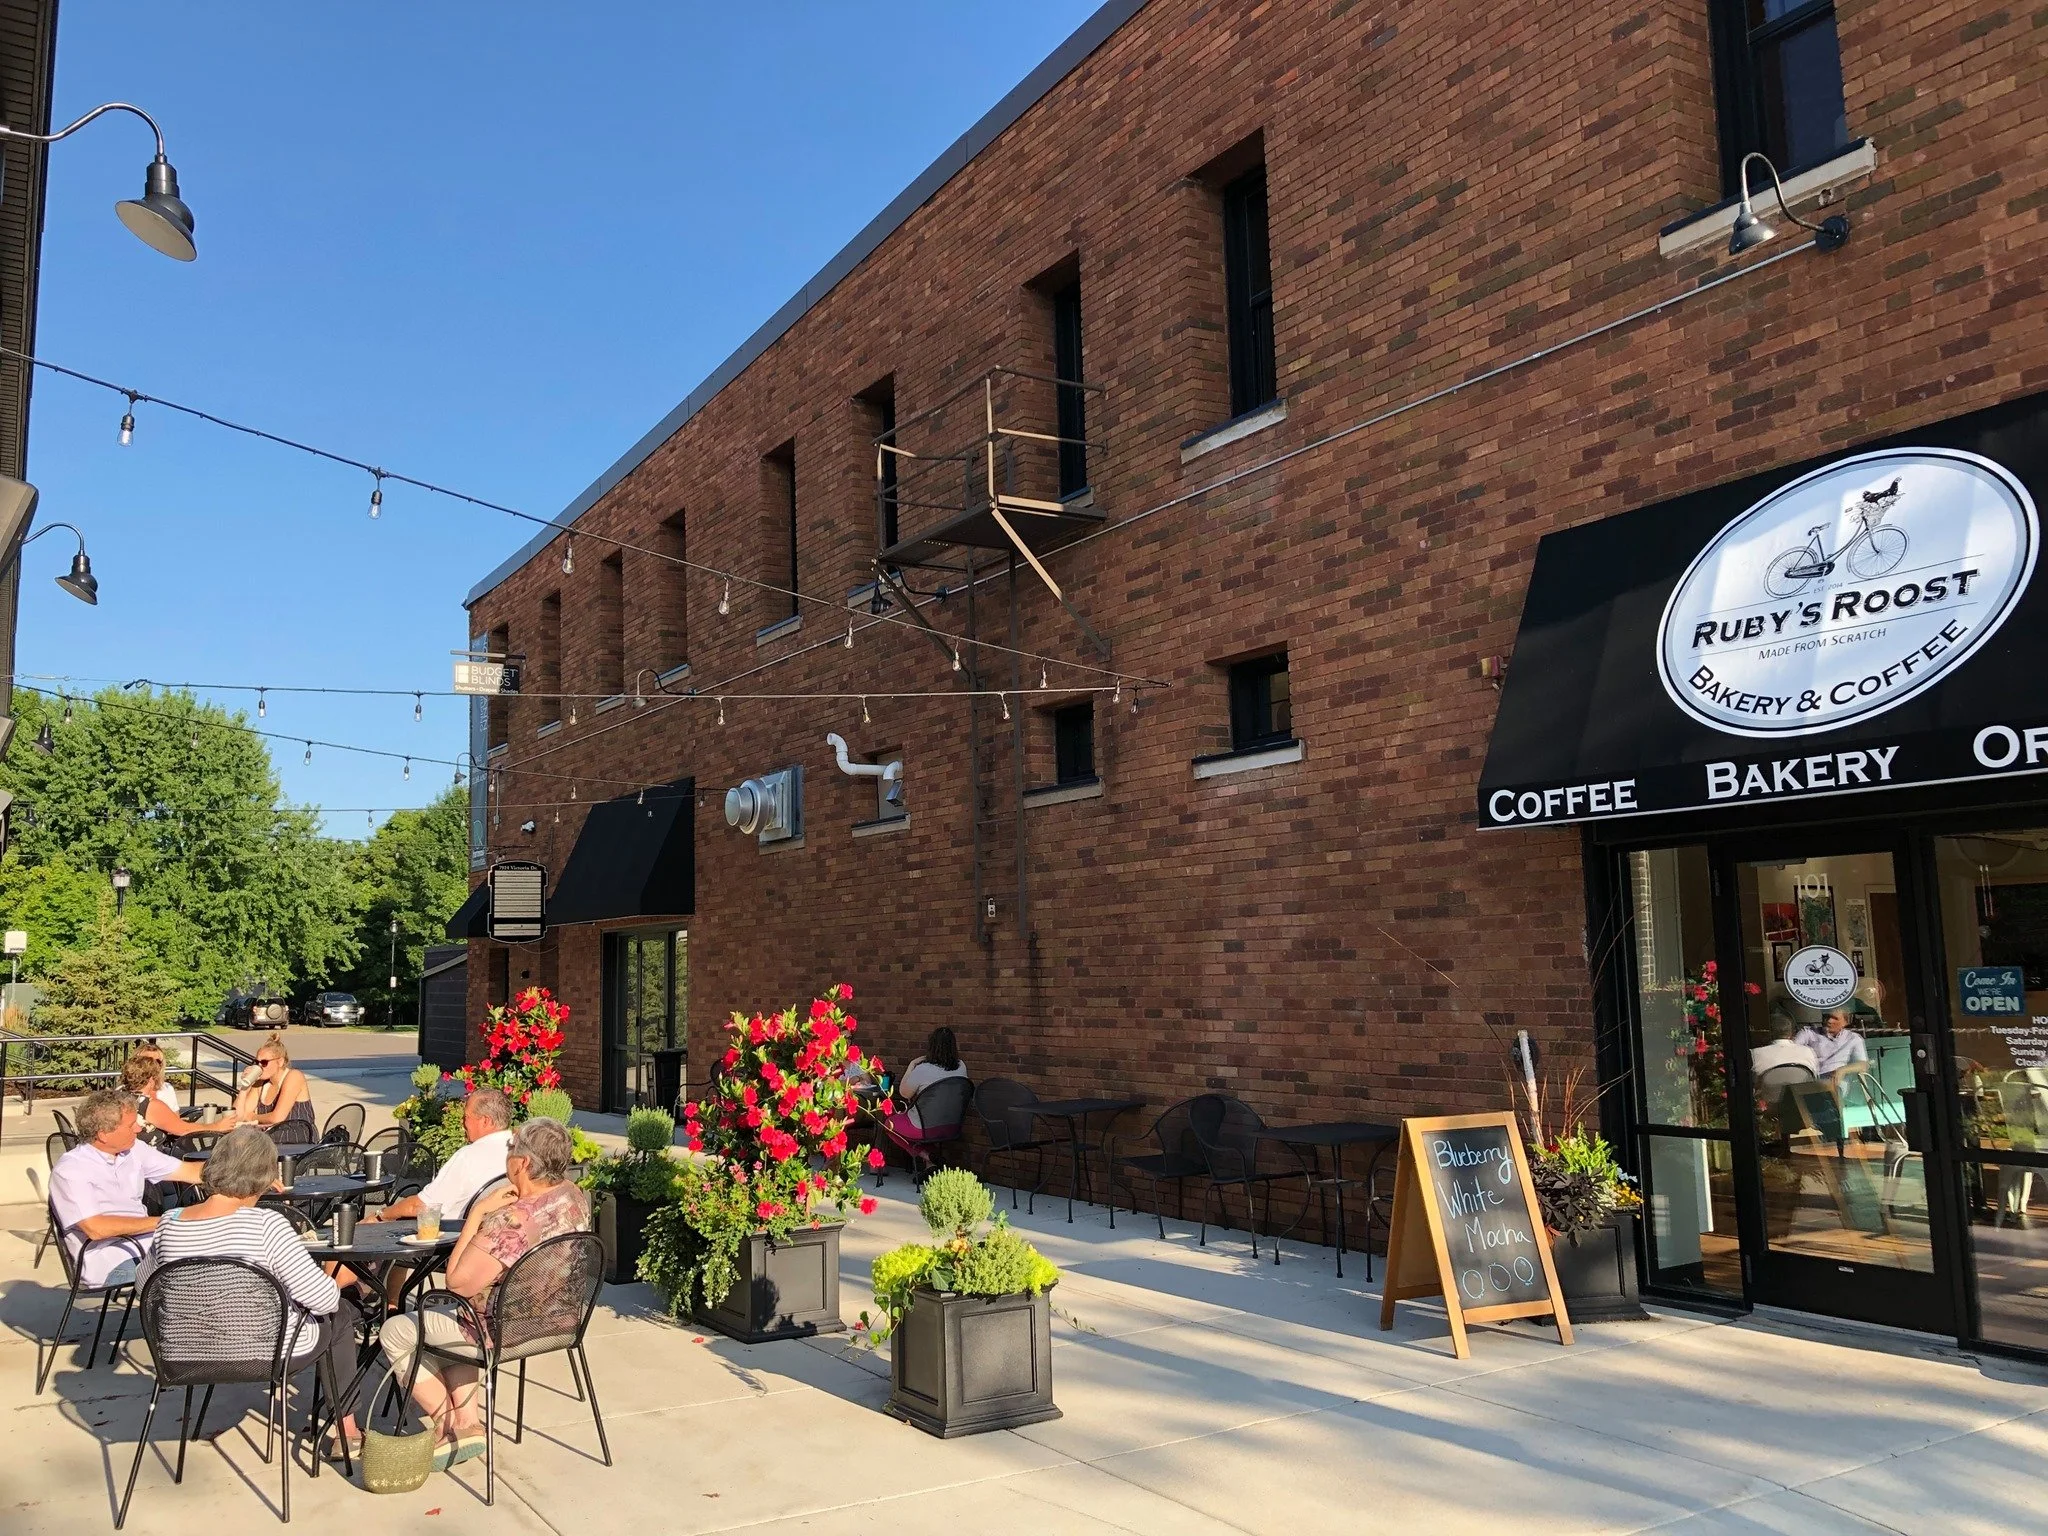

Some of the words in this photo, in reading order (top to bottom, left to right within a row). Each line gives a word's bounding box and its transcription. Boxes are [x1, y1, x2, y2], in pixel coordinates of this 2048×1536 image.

[1692, 601, 1822, 649] RUBY'S
[1832, 569, 1981, 620] ROOST
[1758, 645, 1791, 661] MADE
[1794, 638, 1828, 654] FROM
[1831, 627, 1887, 645] SCRATCH
[471, 666, 517, 677] BUDGET
[1688, 665, 1793, 715] BAKERY
[1796, 689, 1822, 714] &
[1829, 619, 1969, 705] COFFEE
[471, 675, 511, 687] BLINDS
[1489, 779, 1638, 824] COFFEE
[1705, 746, 1900, 801] BAKERY
[1794, 873, 1830, 899] 101
[1793, 977, 1820, 986] RUBY'S
[1822, 977, 1849, 985] ROOST
[1964, 971, 1997, 988] Come
[1999, 971, 2018, 986] In
[1795, 989, 1819, 1004] BAKERY
[1826, 989, 1850, 1004] COFFEE
[1965, 996, 2021, 1012] OPEN
[2032, 1016, 2048, 1024] HO
[2005, 1036, 2048, 1047] Saturday
[2009, 1047, 2046, 1058] Sunday
[1432, 1140, 1514, 1185] Blueberry
[1437, 1176, 1504, 1220] White
[1464, 1217, 1532, 1253] Mocha
